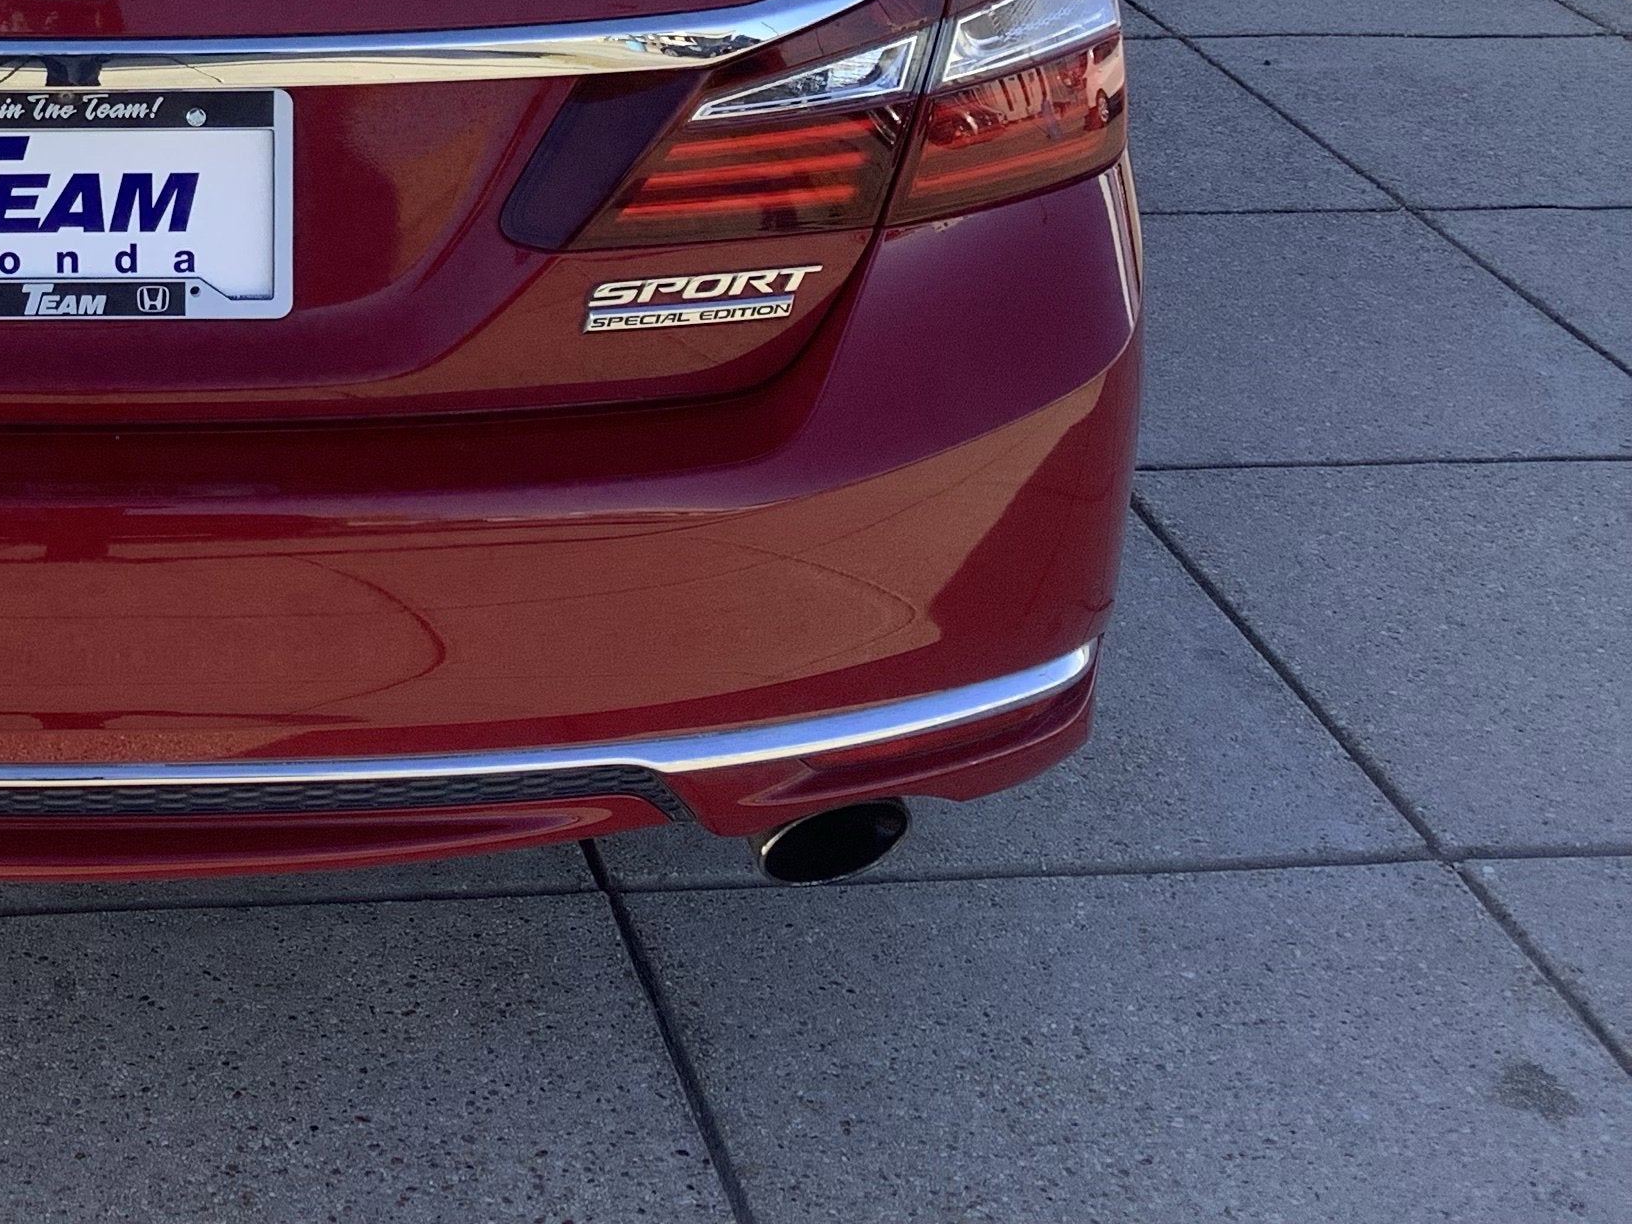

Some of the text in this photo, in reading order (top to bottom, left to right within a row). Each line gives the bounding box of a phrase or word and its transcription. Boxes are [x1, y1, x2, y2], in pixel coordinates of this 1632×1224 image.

[82, 93, 164, 121] Team!
[22, 283, 107, 315] TEAM
[588, 265, 823, 307] SPORT
[590, 302, 792, 329] SPECIAL EDITION
